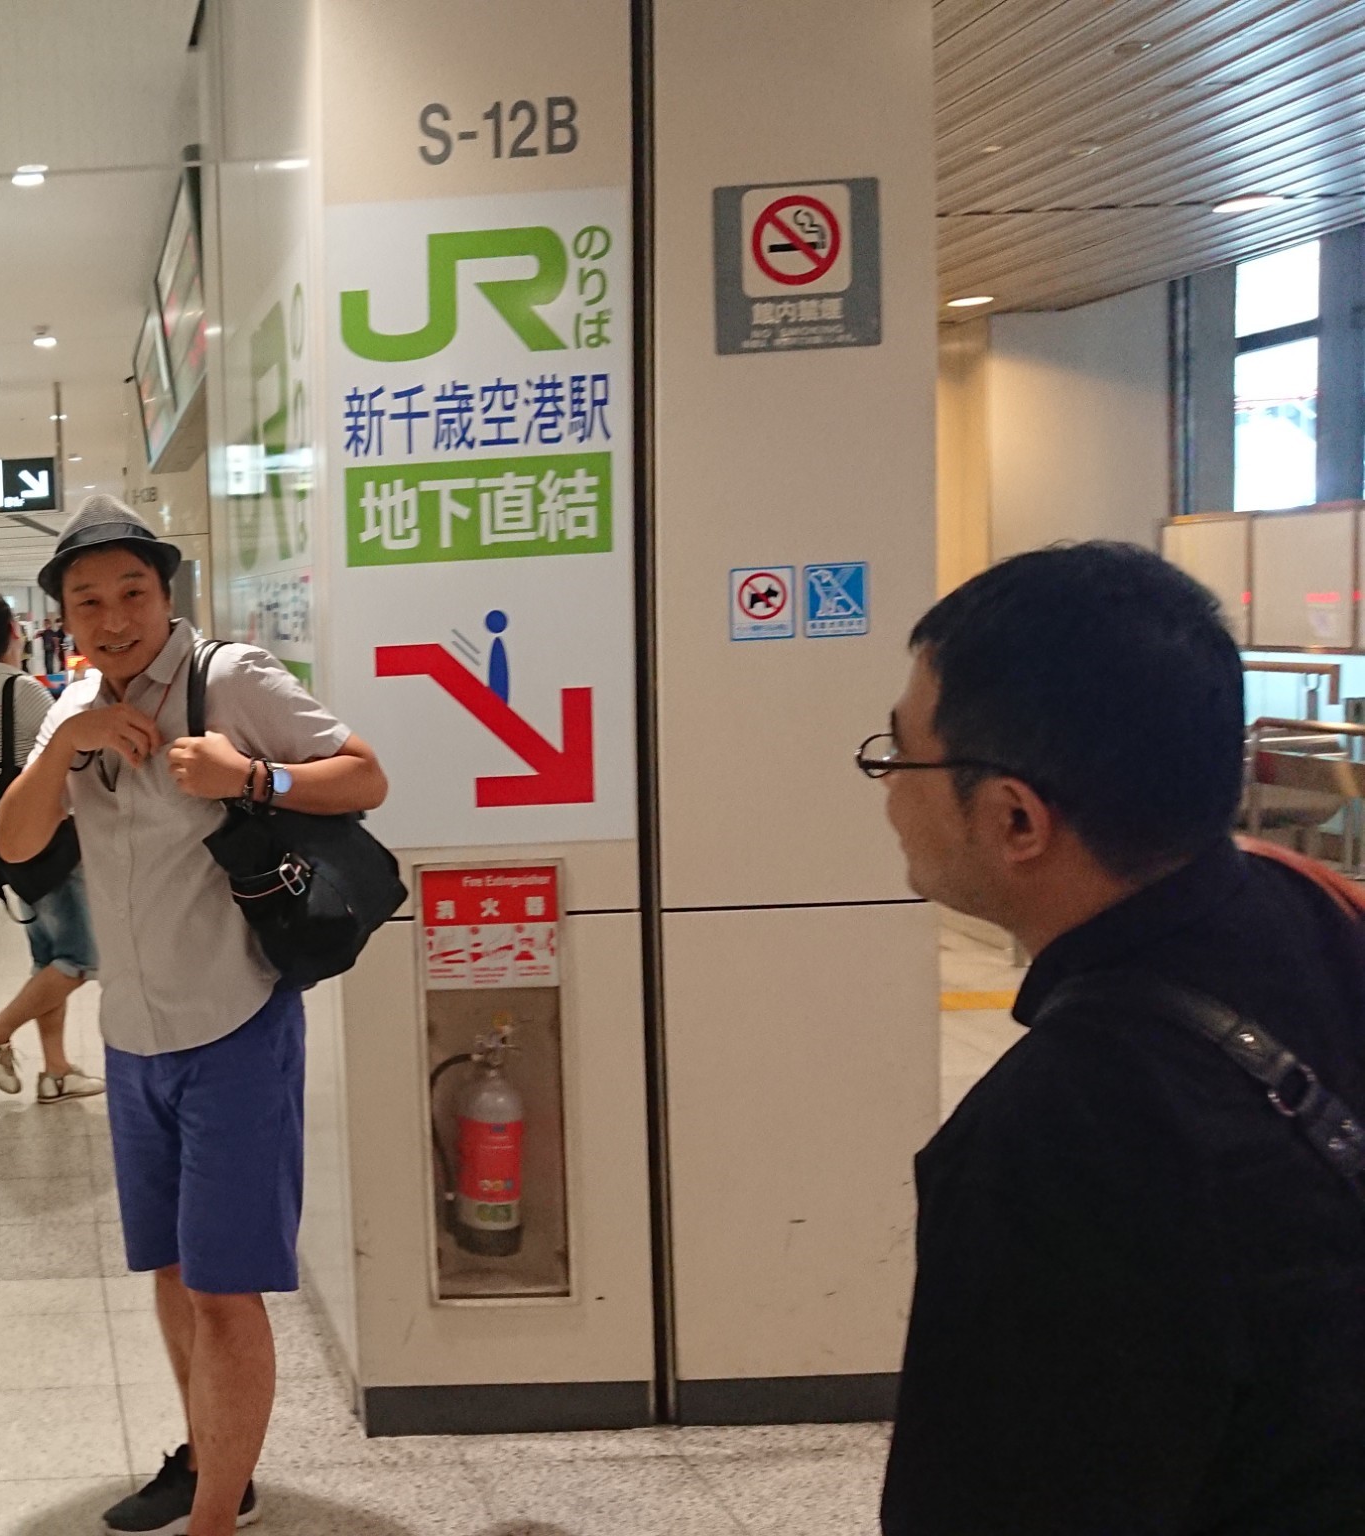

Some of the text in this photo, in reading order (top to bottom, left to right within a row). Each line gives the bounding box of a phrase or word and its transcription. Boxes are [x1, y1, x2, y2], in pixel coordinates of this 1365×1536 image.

[418, 95, 580, 166] S-12B
[340, 225, 568, 362] JR
[572, 224, 612, 350] のりば
[344, 372, 611, 457] 新千歳空港駅
[359, 469, 600, 550] 地下直結
[462, 874, 551, 888] Fire Extinguisher
